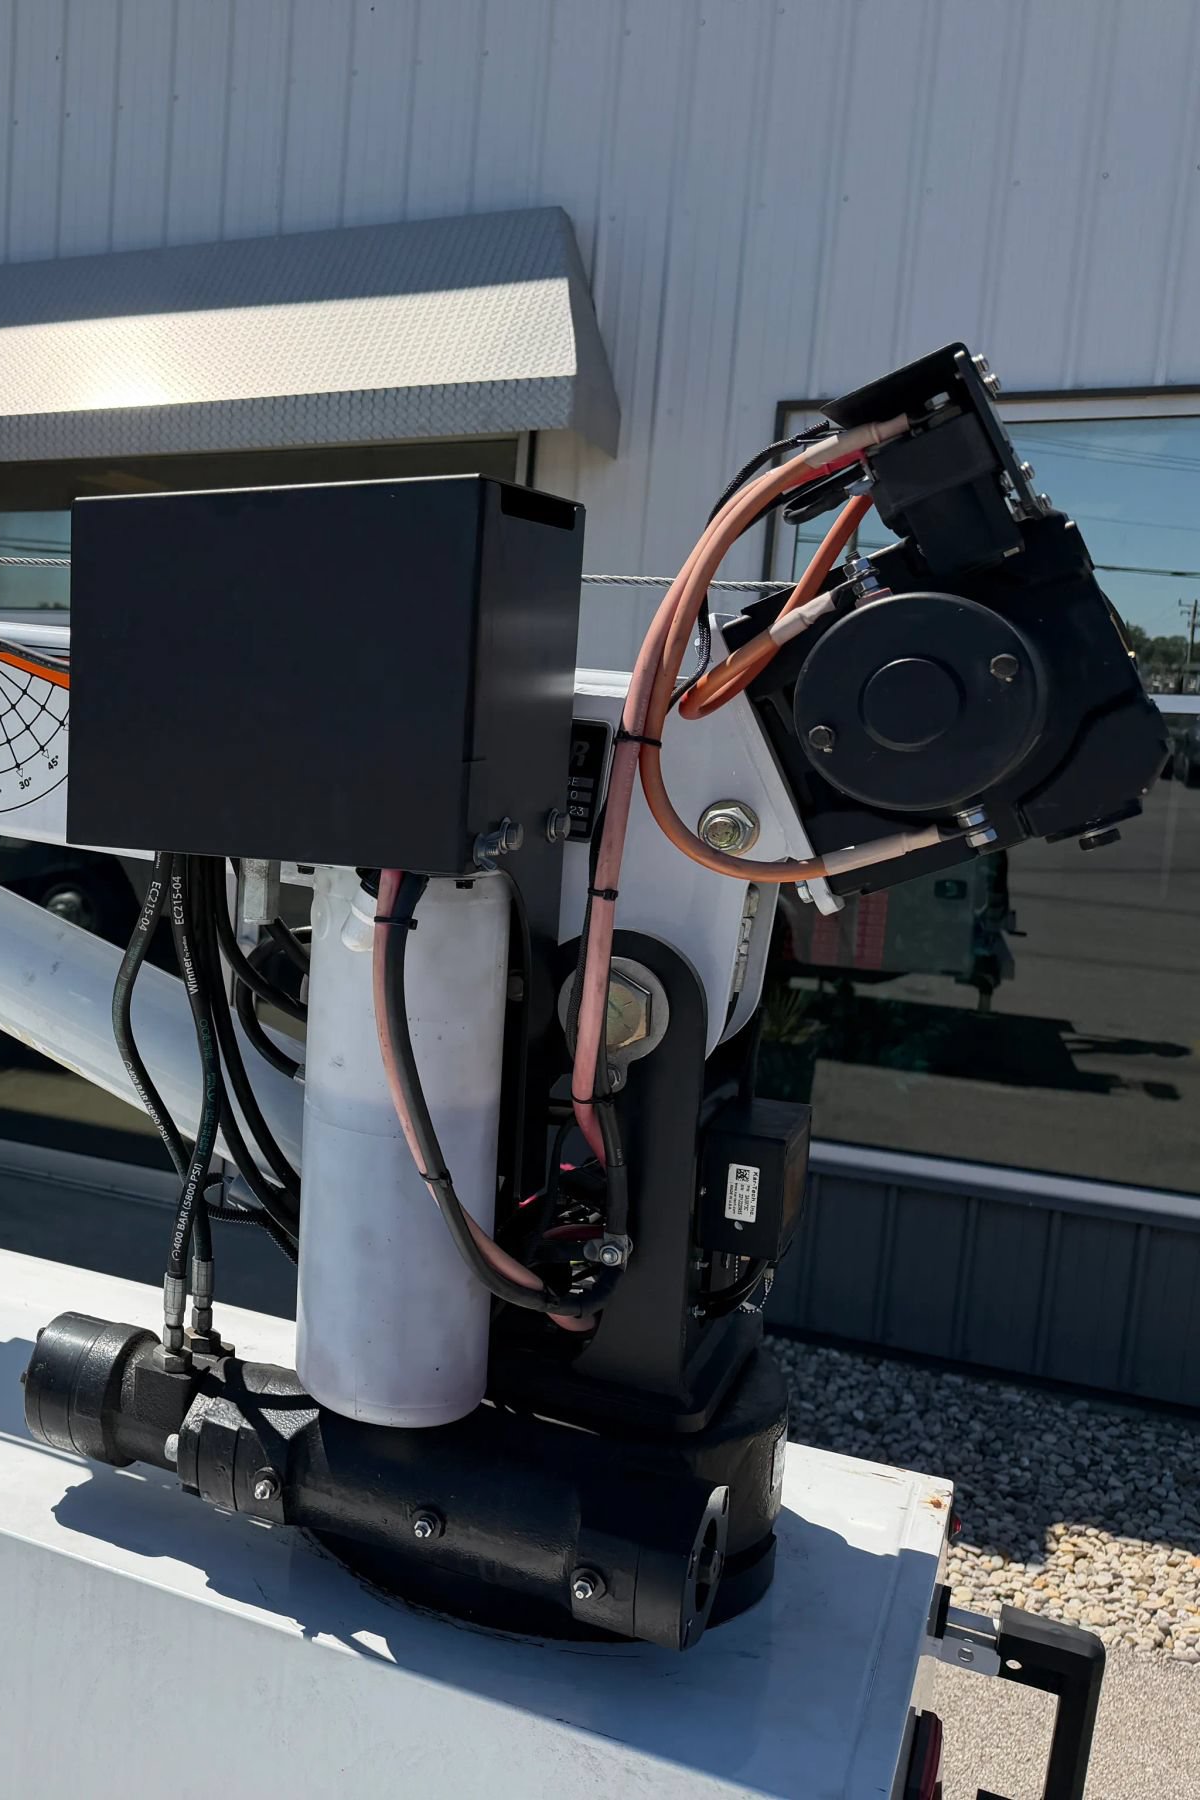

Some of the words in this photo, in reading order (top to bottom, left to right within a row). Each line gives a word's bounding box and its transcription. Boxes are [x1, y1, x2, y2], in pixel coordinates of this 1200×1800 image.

[18, 777, 32, 790] 30°
[139, 881, 162, 931] EC215-04
[171, 876, 184, 925] EC215-04
[184, 957, 199, 995] Winner
[190, 1162, 204, 1182] PSI)
[181, 1182, 197, 1210] (5800
[177, 1210, 189, 1231] BAR
[173, 1231, 184, 1249] 400
